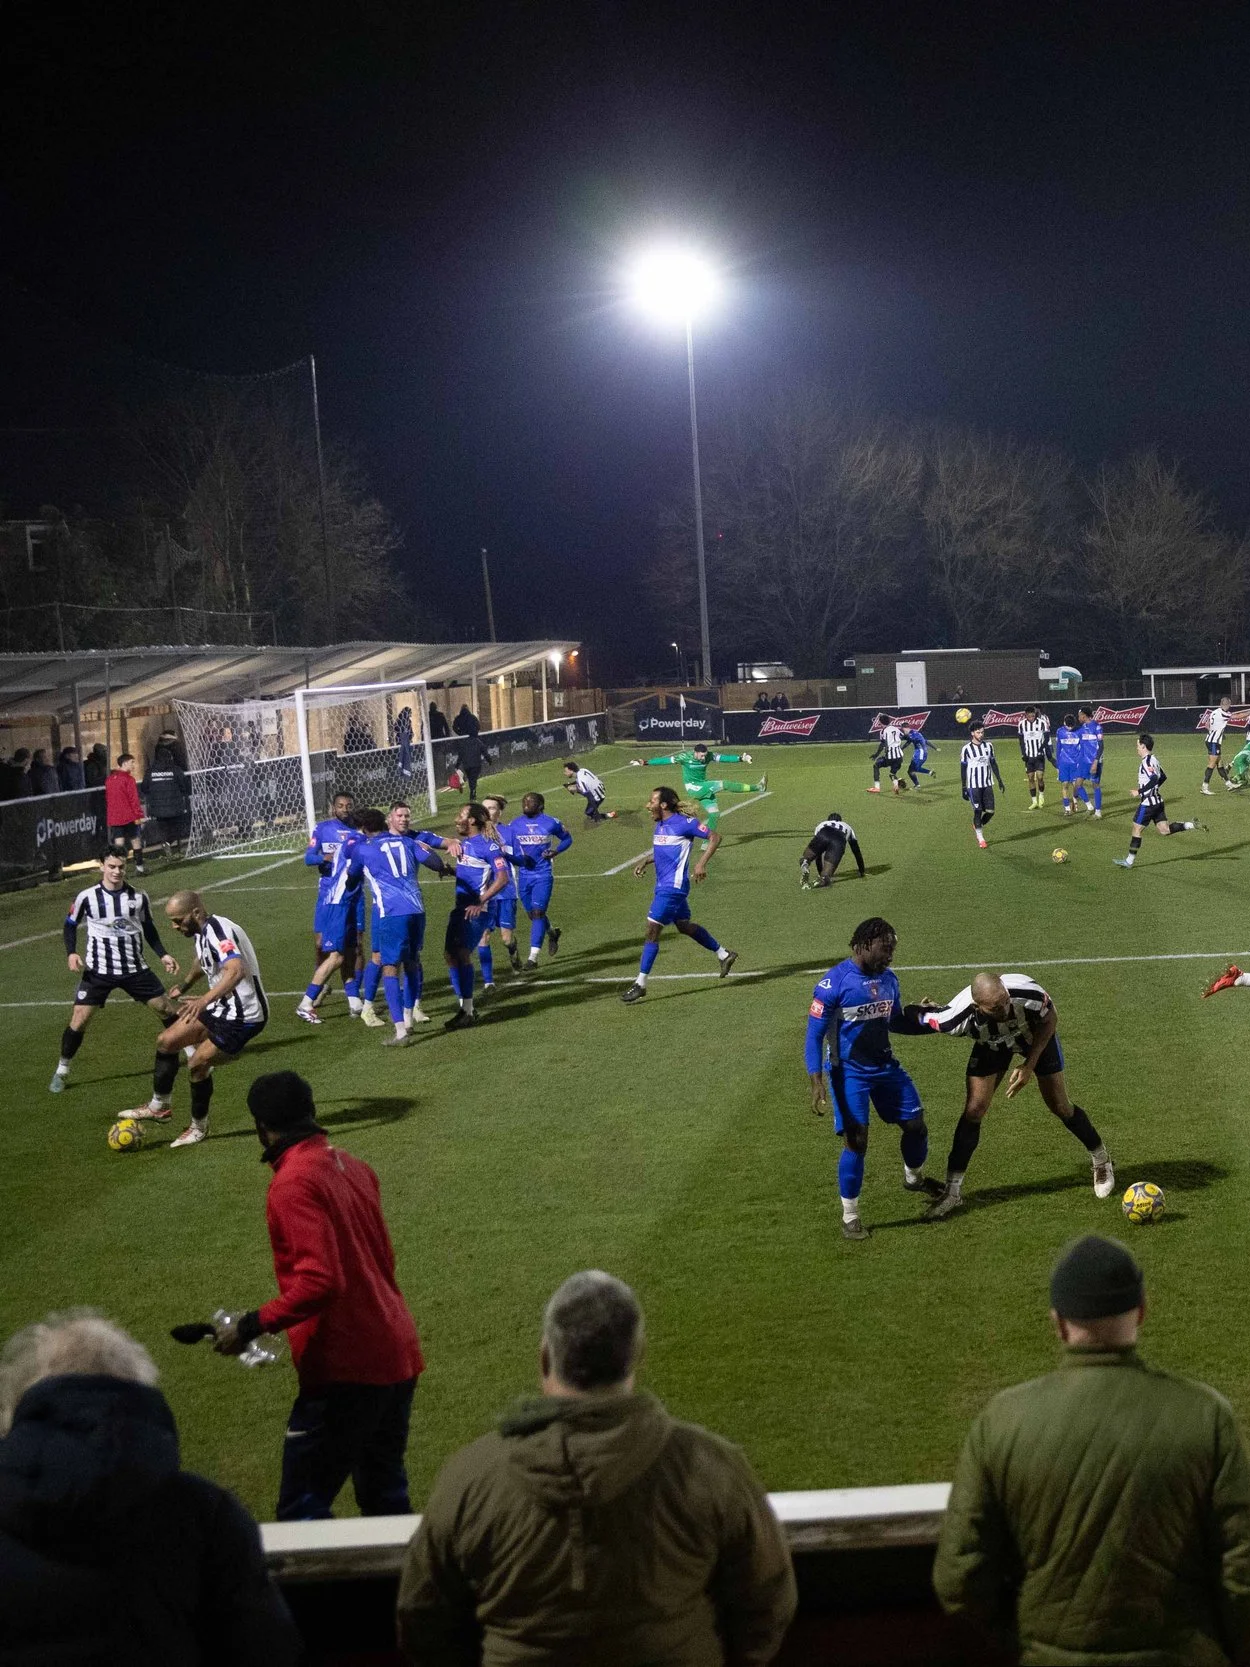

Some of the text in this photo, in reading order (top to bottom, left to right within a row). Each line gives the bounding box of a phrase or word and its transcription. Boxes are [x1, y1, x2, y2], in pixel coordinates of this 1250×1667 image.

[1093, 708, 1145, 722] Budweiser
[650, 718, 706, 729] Powerday
[760, 720, 815, 732] Budweiser
[891, 730, 897, 742] 7
[46, 813, 97, 839] Powerday
[380, 841, 408, 878] 17
